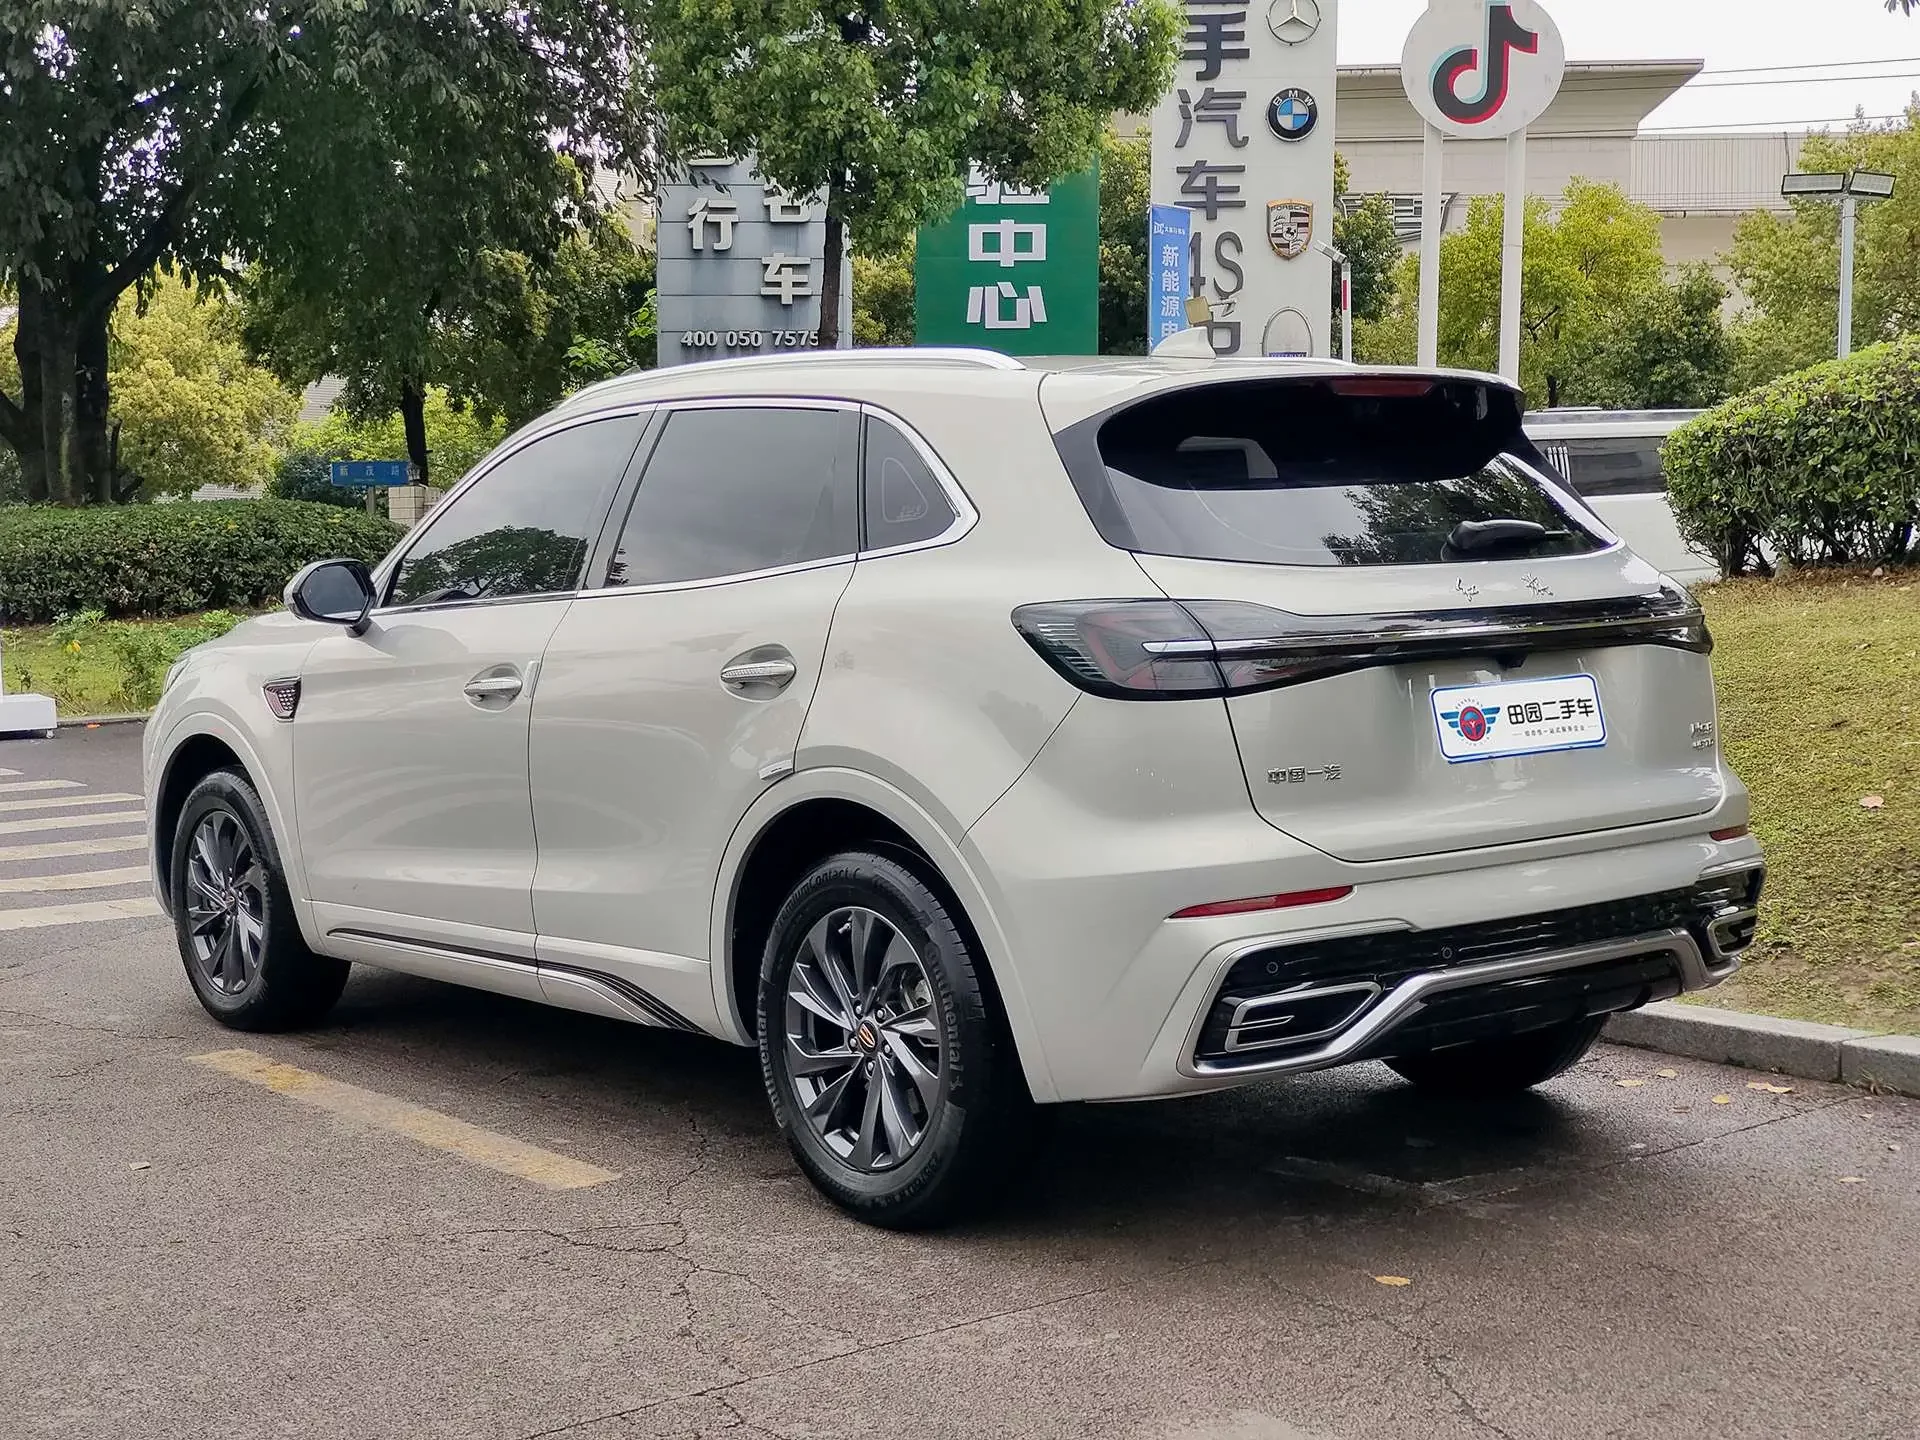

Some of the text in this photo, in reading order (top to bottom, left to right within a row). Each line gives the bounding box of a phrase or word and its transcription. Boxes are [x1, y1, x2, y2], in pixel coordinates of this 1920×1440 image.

[1272, 90, 1315, 108] BMW
[1174, 0, 1251, 354] 手汽车4S
[680, 330, 819, 348] 400 050 7575
[1507, 697, 1595, 725] 田园二手车
[1267, 764, 1342, 784] 中国一汽
